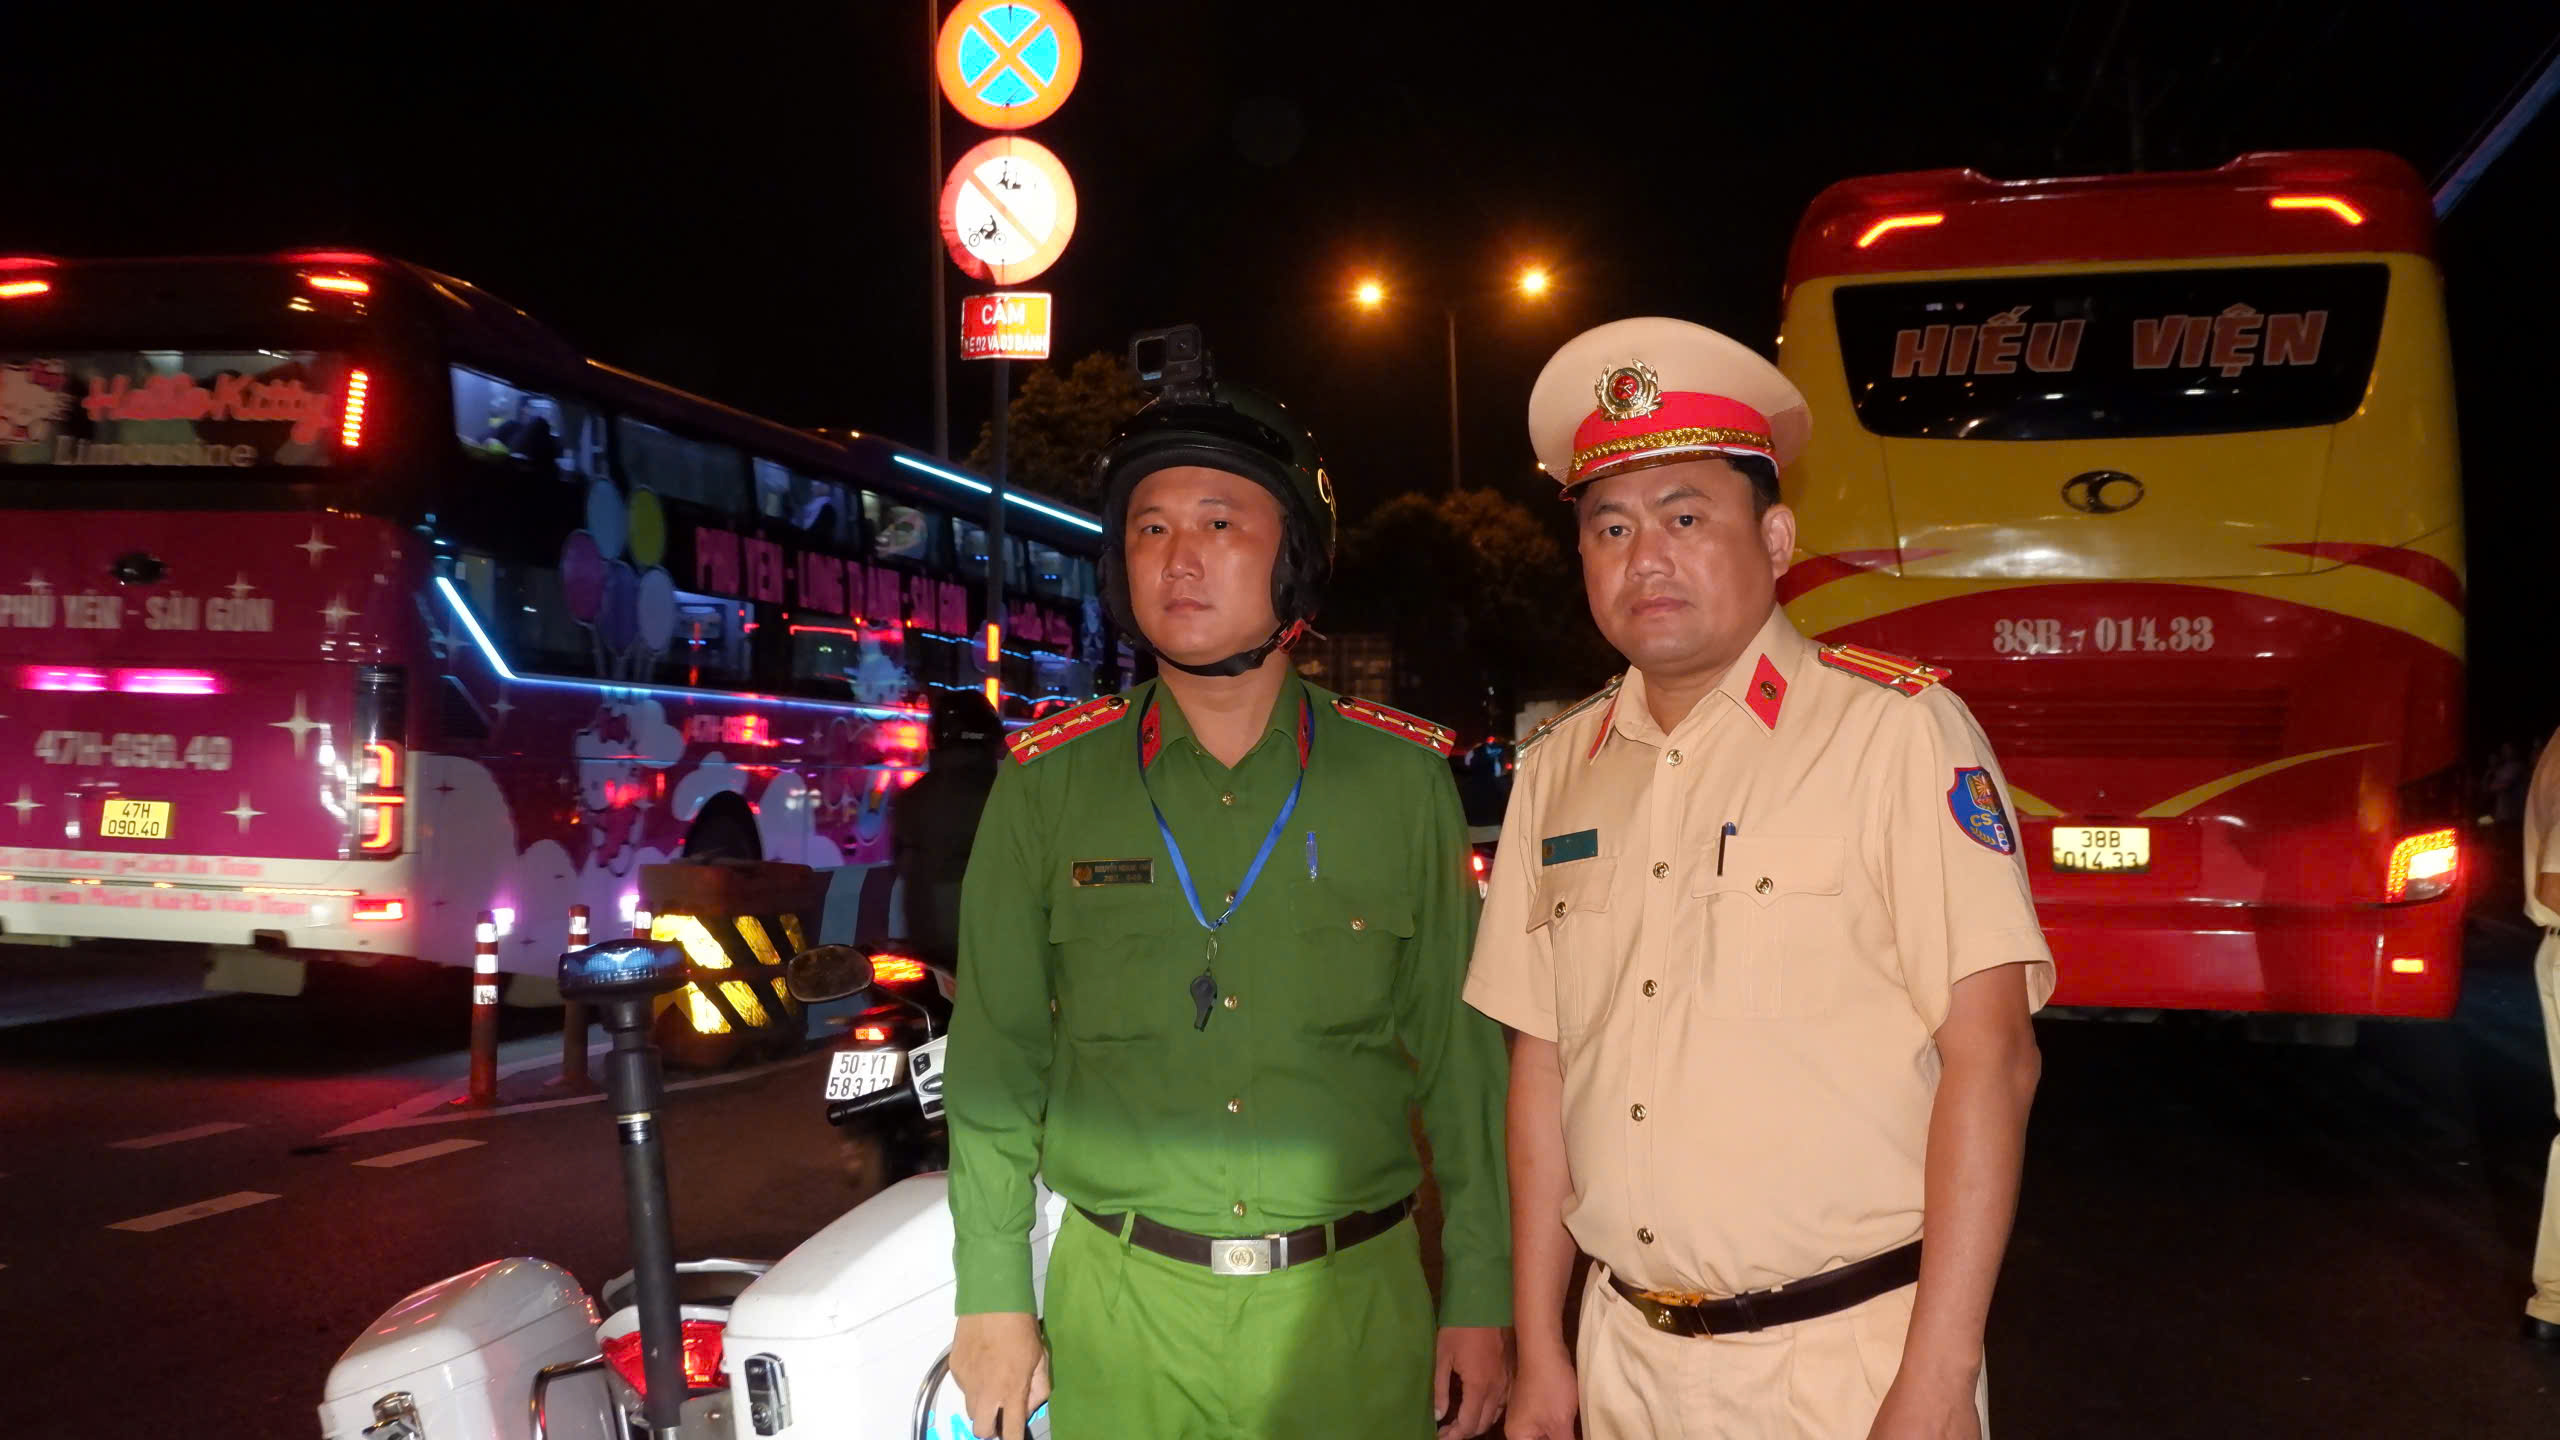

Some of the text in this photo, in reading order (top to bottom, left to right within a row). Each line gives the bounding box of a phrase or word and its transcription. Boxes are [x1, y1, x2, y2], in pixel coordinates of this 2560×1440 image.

[982, 297, 1025, 325] CẤM
[1892, 303, 2328, 377] HIẾU VIỆN
[83, 373, 211, 422] Hello
[55, 433, 258, 467] Limousine
[64, 589, 124, 630] YÊN
[145, 590, 201, 632] SÀI
[206, 590, 273, 633] GÒN
[1993, 618, 2062, 654] 38B
[2095, 616, 2215, 652] 014.33
[122, 803, 151, 819] 47H
[1970, 813, 1993, 826] CS
[108, 820, 159, 836] 090.40
[2081, 830, 2121, 848] 38B
[2064, 851, 2138, 870] 014.33
[839, 1054, 887, 1075] 50-Y1
